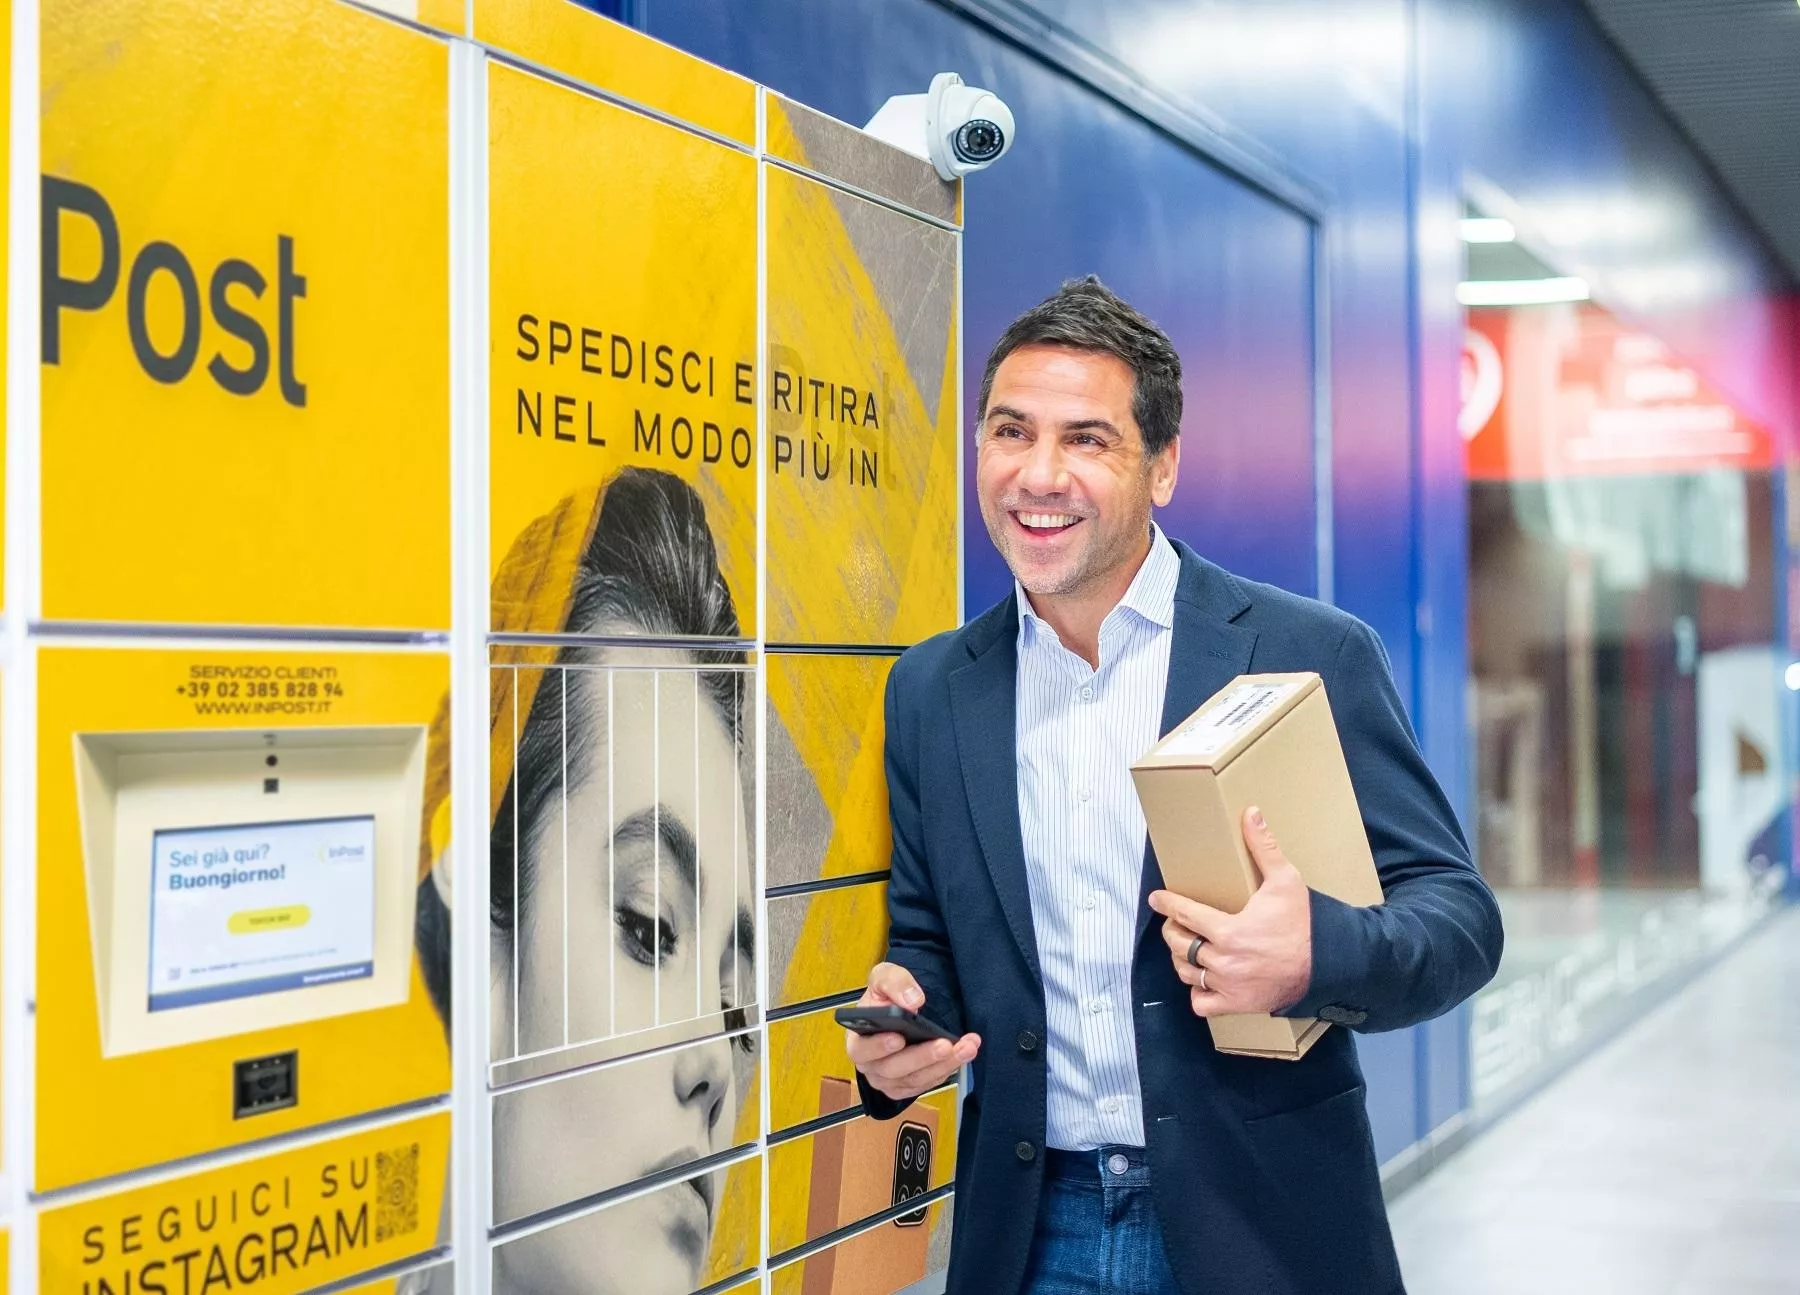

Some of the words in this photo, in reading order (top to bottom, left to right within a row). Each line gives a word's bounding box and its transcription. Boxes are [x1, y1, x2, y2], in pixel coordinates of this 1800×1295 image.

[40, 173, 307, 408] Post
[516, 313, 714, 398] SPEDISCI
[735, 362, 753, 405] E
[774, 370, 879, 429] RITIRA
[517, 388, 606, 448] NEL
[634, 409, 752, 469] MODO
[775, 432, 830, 481] PIÙ
[850, 448, 878, 489] IN
[176, 682, 211, 697] +39
[217, 682, 240, 697] 02
[246, 682, 280, 697] 385
[285, 682, 318, 697] 828
[324, 682, 343, 697] 94
[189, 664, 271, 679] SERVIZIO
[275, 666, 337, 679] CLIENTI
[195, 701, 332, 714] WWW.INPOST.IT
[169, 849, 198, 868] Sei
[203, 845, 229, 869] già
[234, 843, 271, 864] qui?
[169, 864, 286, 890] Buongiorno!
[82, 1176, 291, 1264] SEGUICI
[321, 1156, 369, 1198] SU
[83, 1202, 369, 1295] STAGRAM
